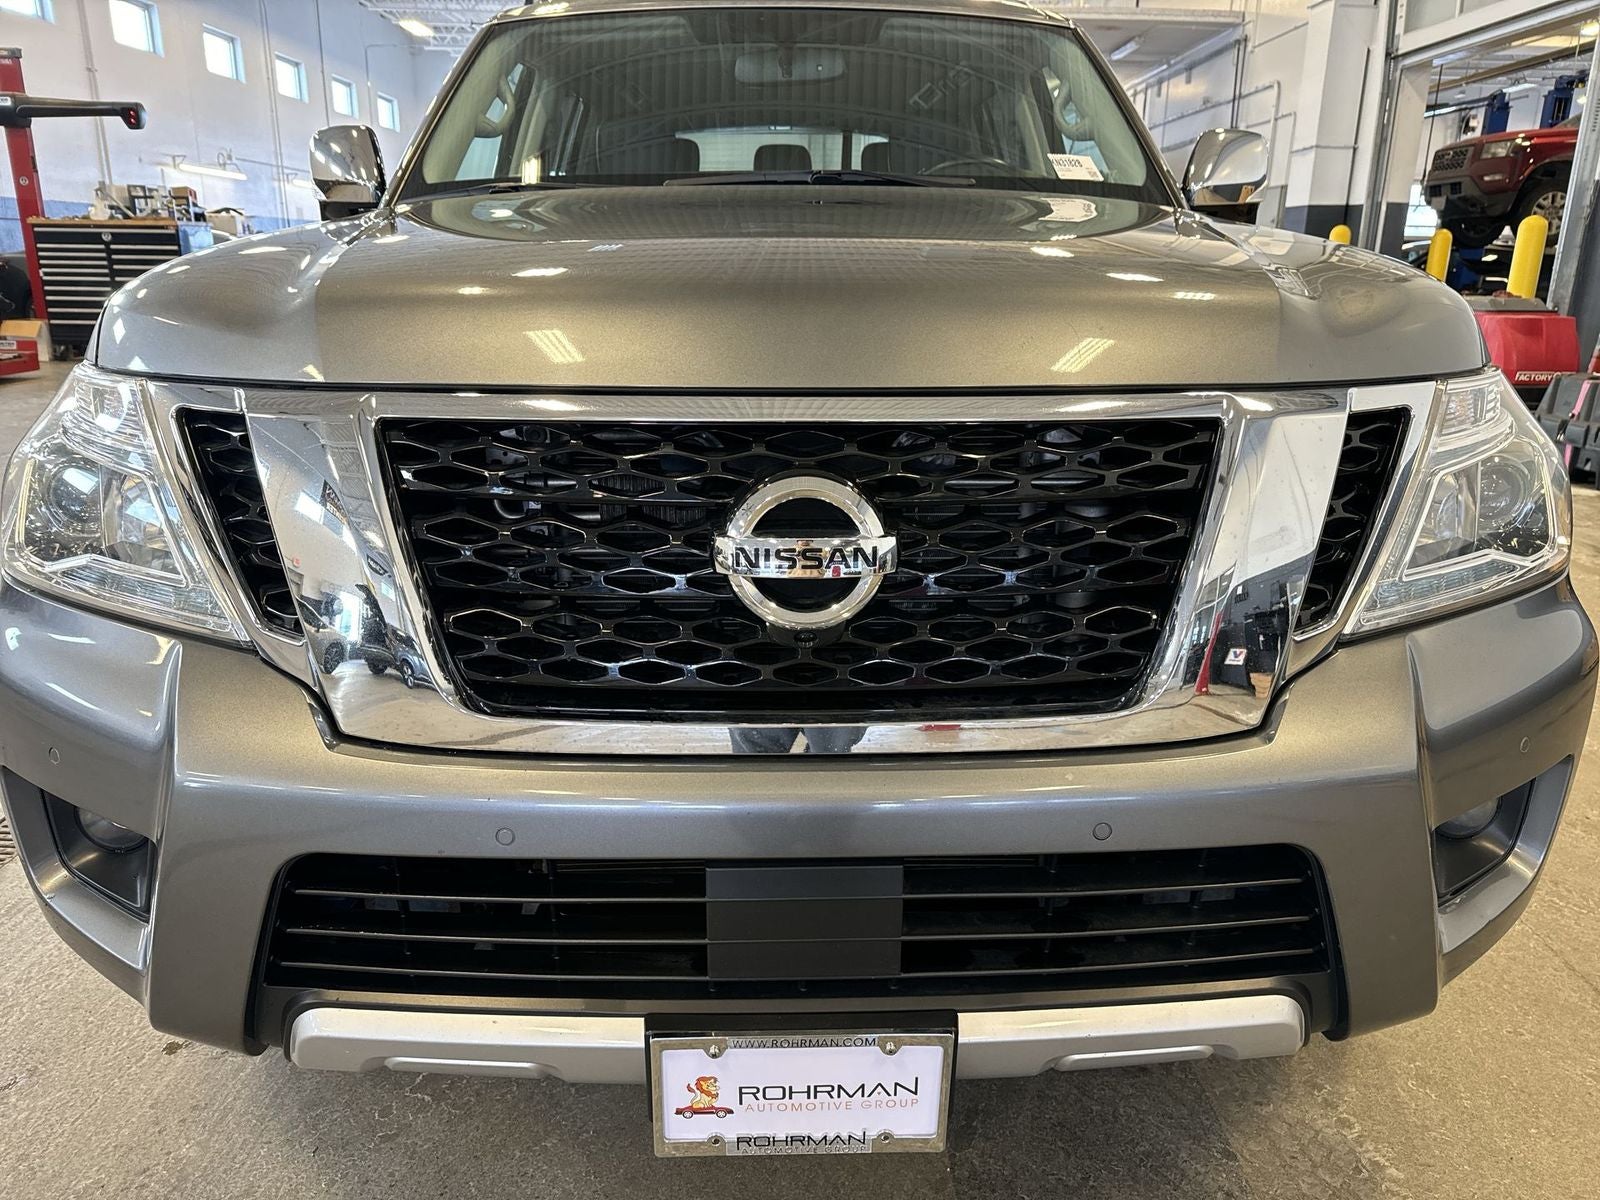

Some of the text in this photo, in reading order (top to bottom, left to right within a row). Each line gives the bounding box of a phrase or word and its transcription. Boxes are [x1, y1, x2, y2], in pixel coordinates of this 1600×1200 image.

[735, 546, 879, 570] NISSAN
[732, 1037, 877, 1049] WWW.ROHRMAN.COM
[738, 1076, 919, 1106] ROHRMAN
[745, 1098, 920, 1114] AUTOMOTIVE GROUP
[736, 1131, 867, 1151] ROHRMAN
